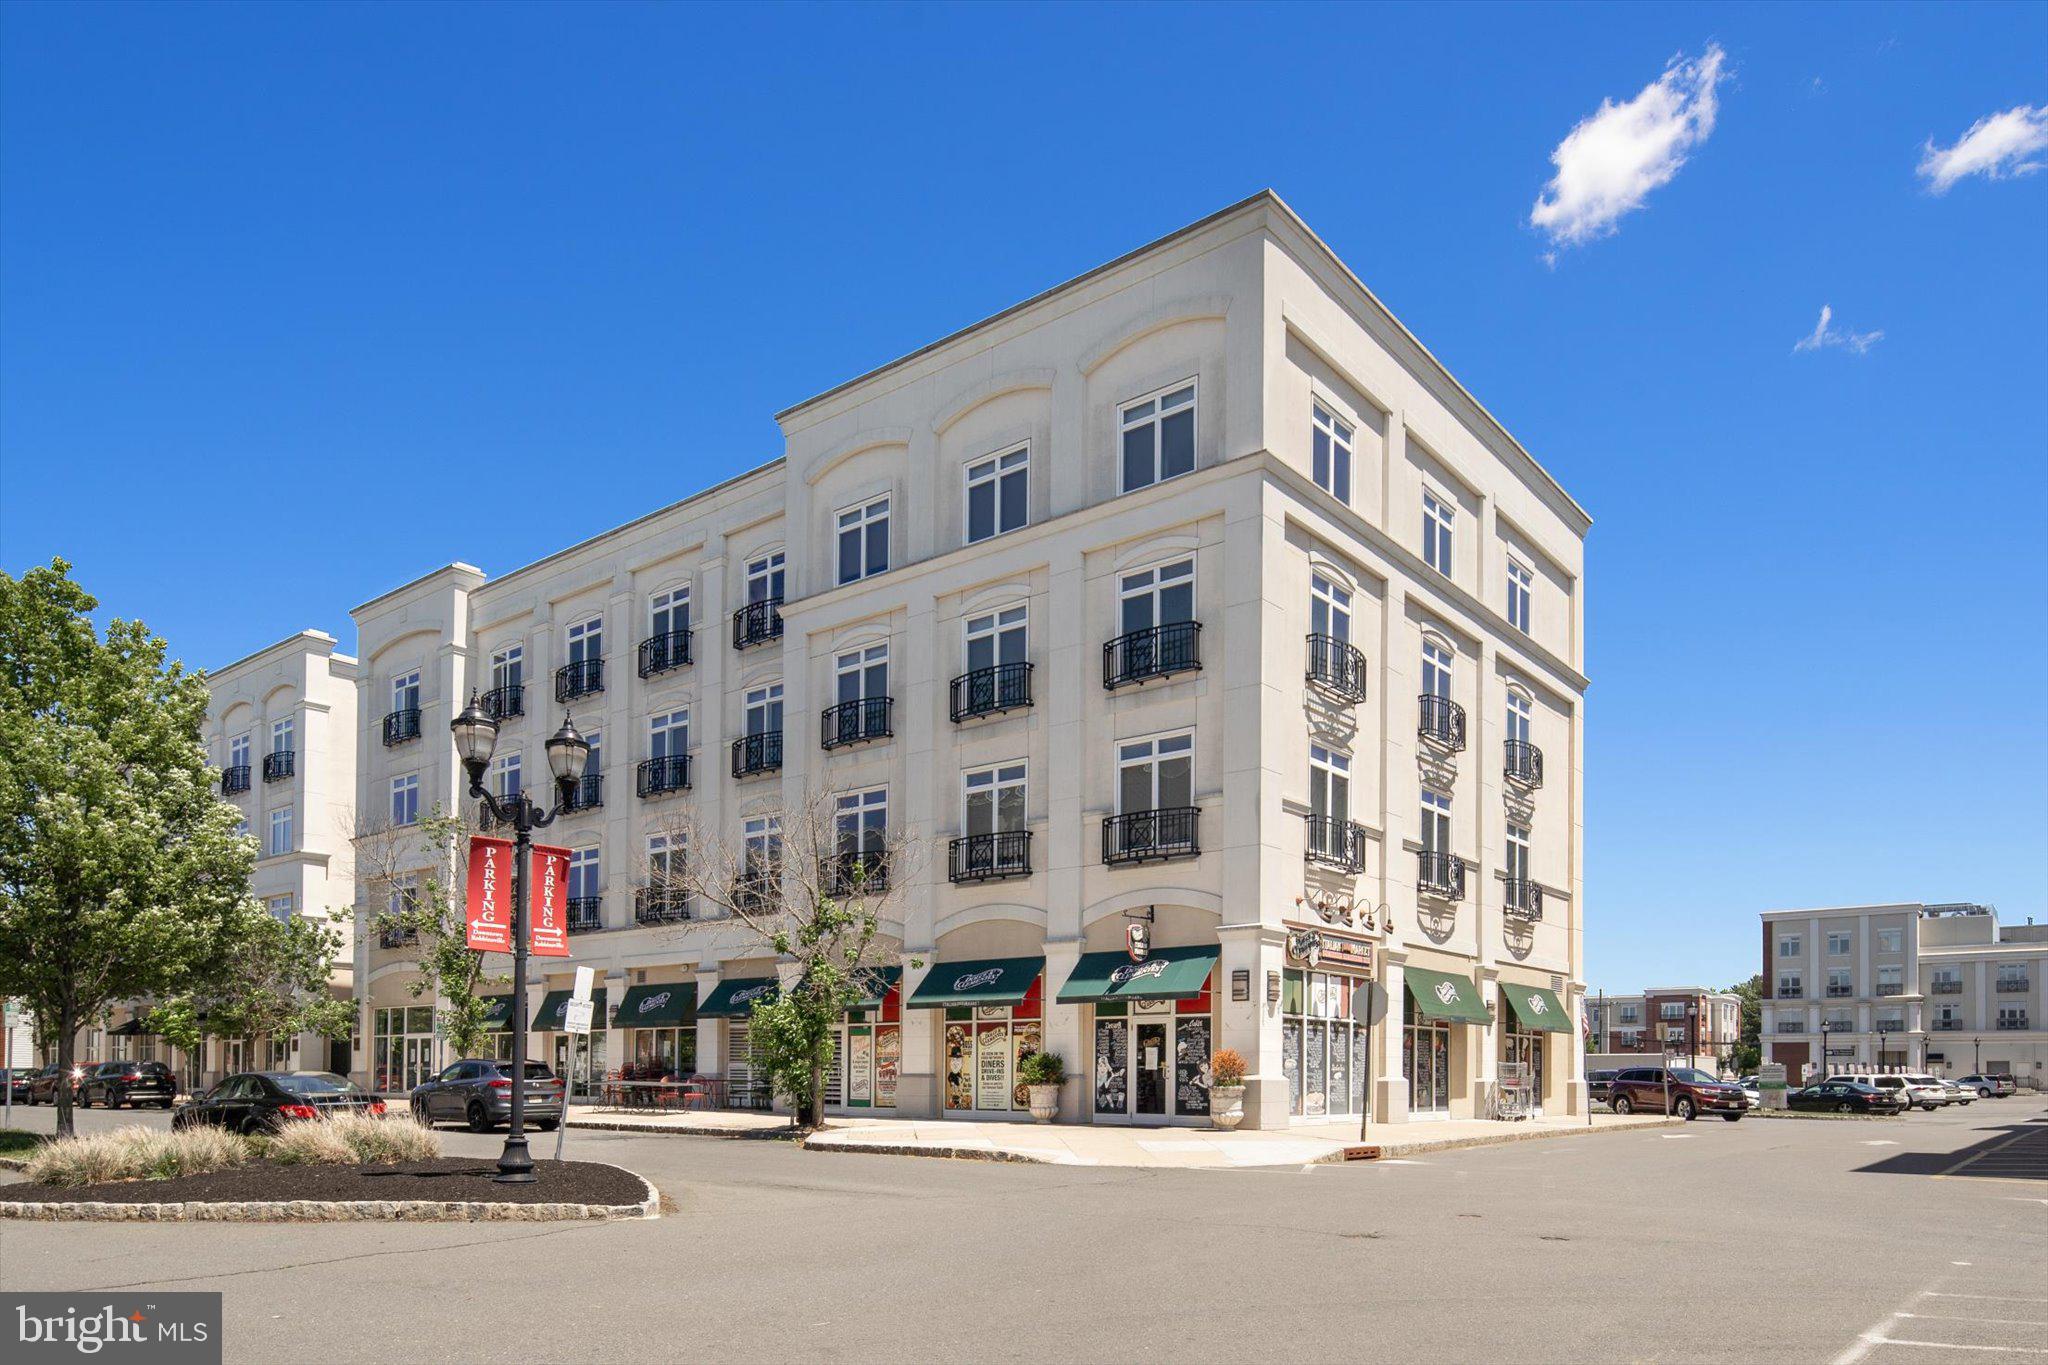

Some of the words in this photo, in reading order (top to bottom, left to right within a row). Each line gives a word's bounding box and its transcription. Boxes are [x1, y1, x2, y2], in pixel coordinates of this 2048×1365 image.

[482, 846, 497, 922] PARKING
[543, 855, 557, 927] PARKING
[981, 1060, 1005, 1068] DINERS
